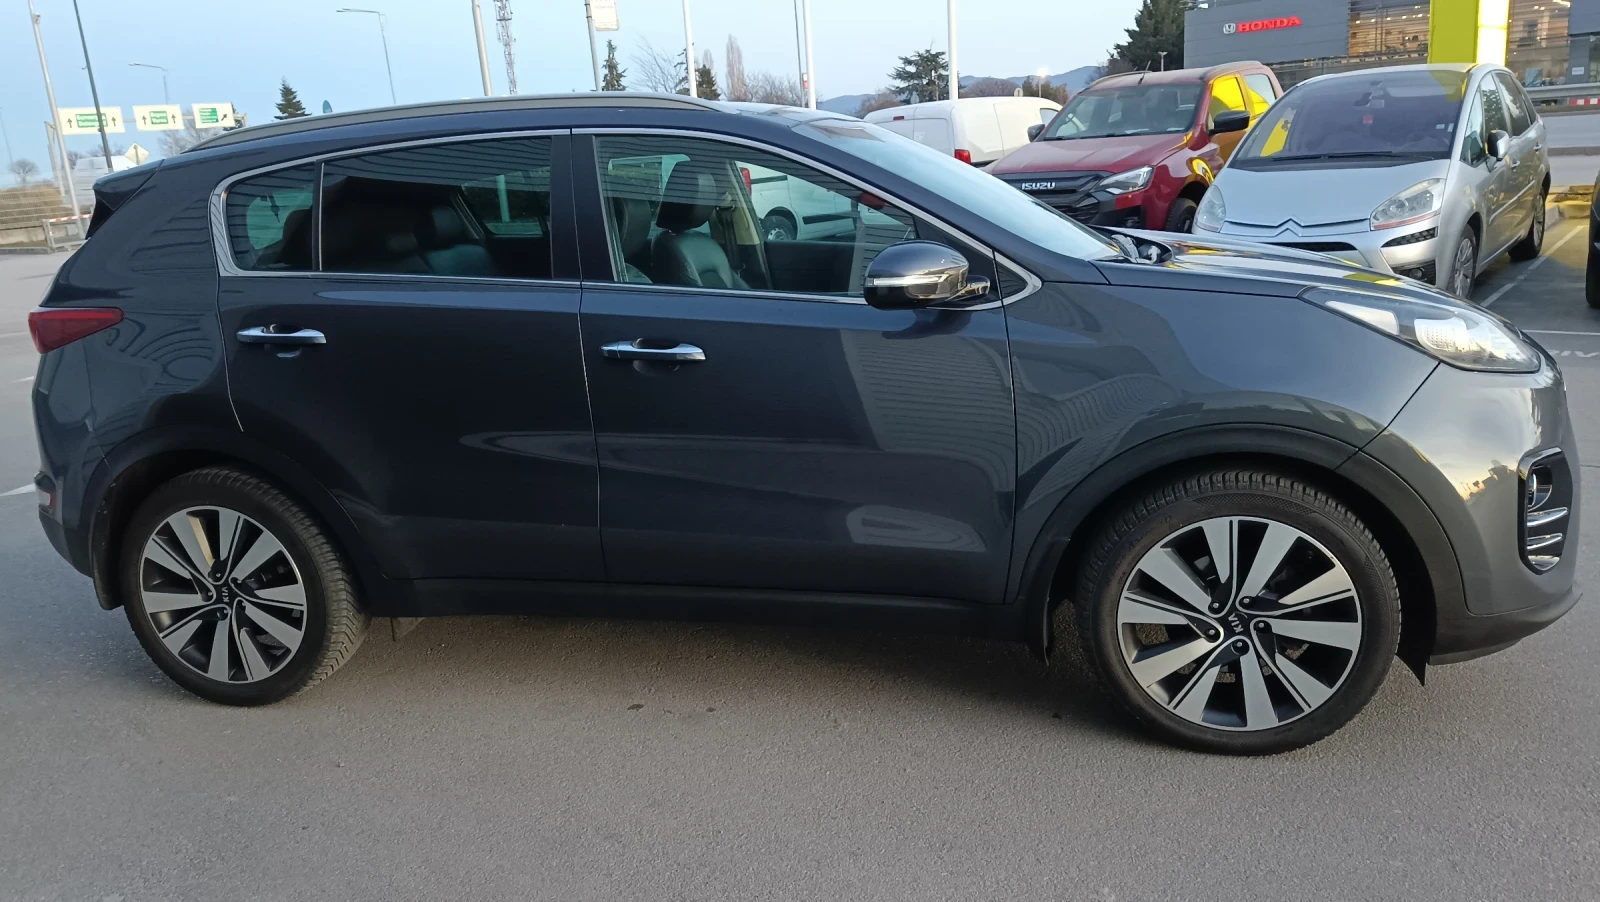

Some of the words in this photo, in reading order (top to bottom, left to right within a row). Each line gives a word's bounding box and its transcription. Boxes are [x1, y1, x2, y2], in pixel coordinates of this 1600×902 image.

[1237, 16, 1302, 34] HONDA
[1021, 182, 1056, 190] ISUZU
[221, 586, 230, 603] KIA
[1228, 612, 1244, 634] KIA
